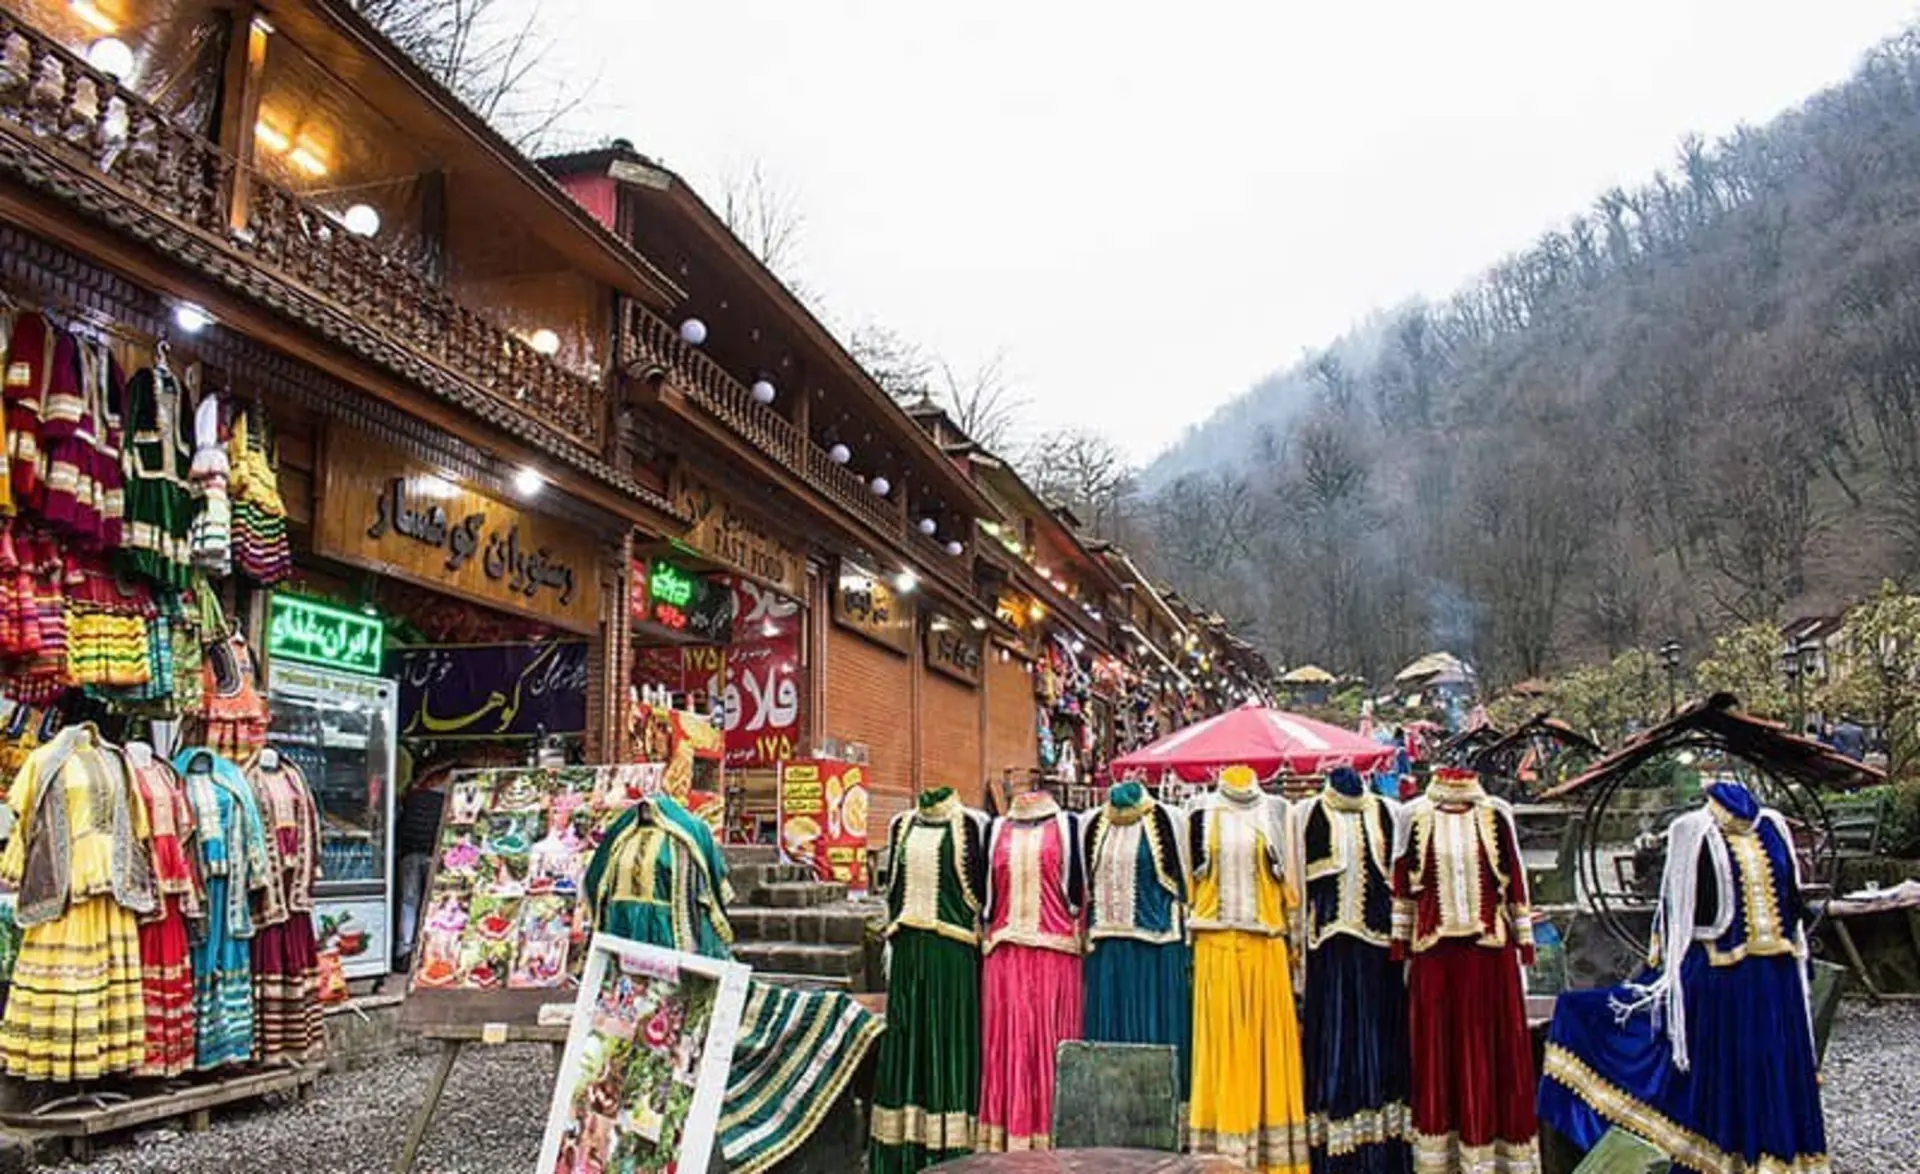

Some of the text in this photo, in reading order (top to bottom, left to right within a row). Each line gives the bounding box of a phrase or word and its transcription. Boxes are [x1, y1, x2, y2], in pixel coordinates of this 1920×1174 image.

[367, 478, 486, 571] کوهسار
[714, 526, 785, 583] FAST FOOD
[484, 525, 574, 606] رستوران
